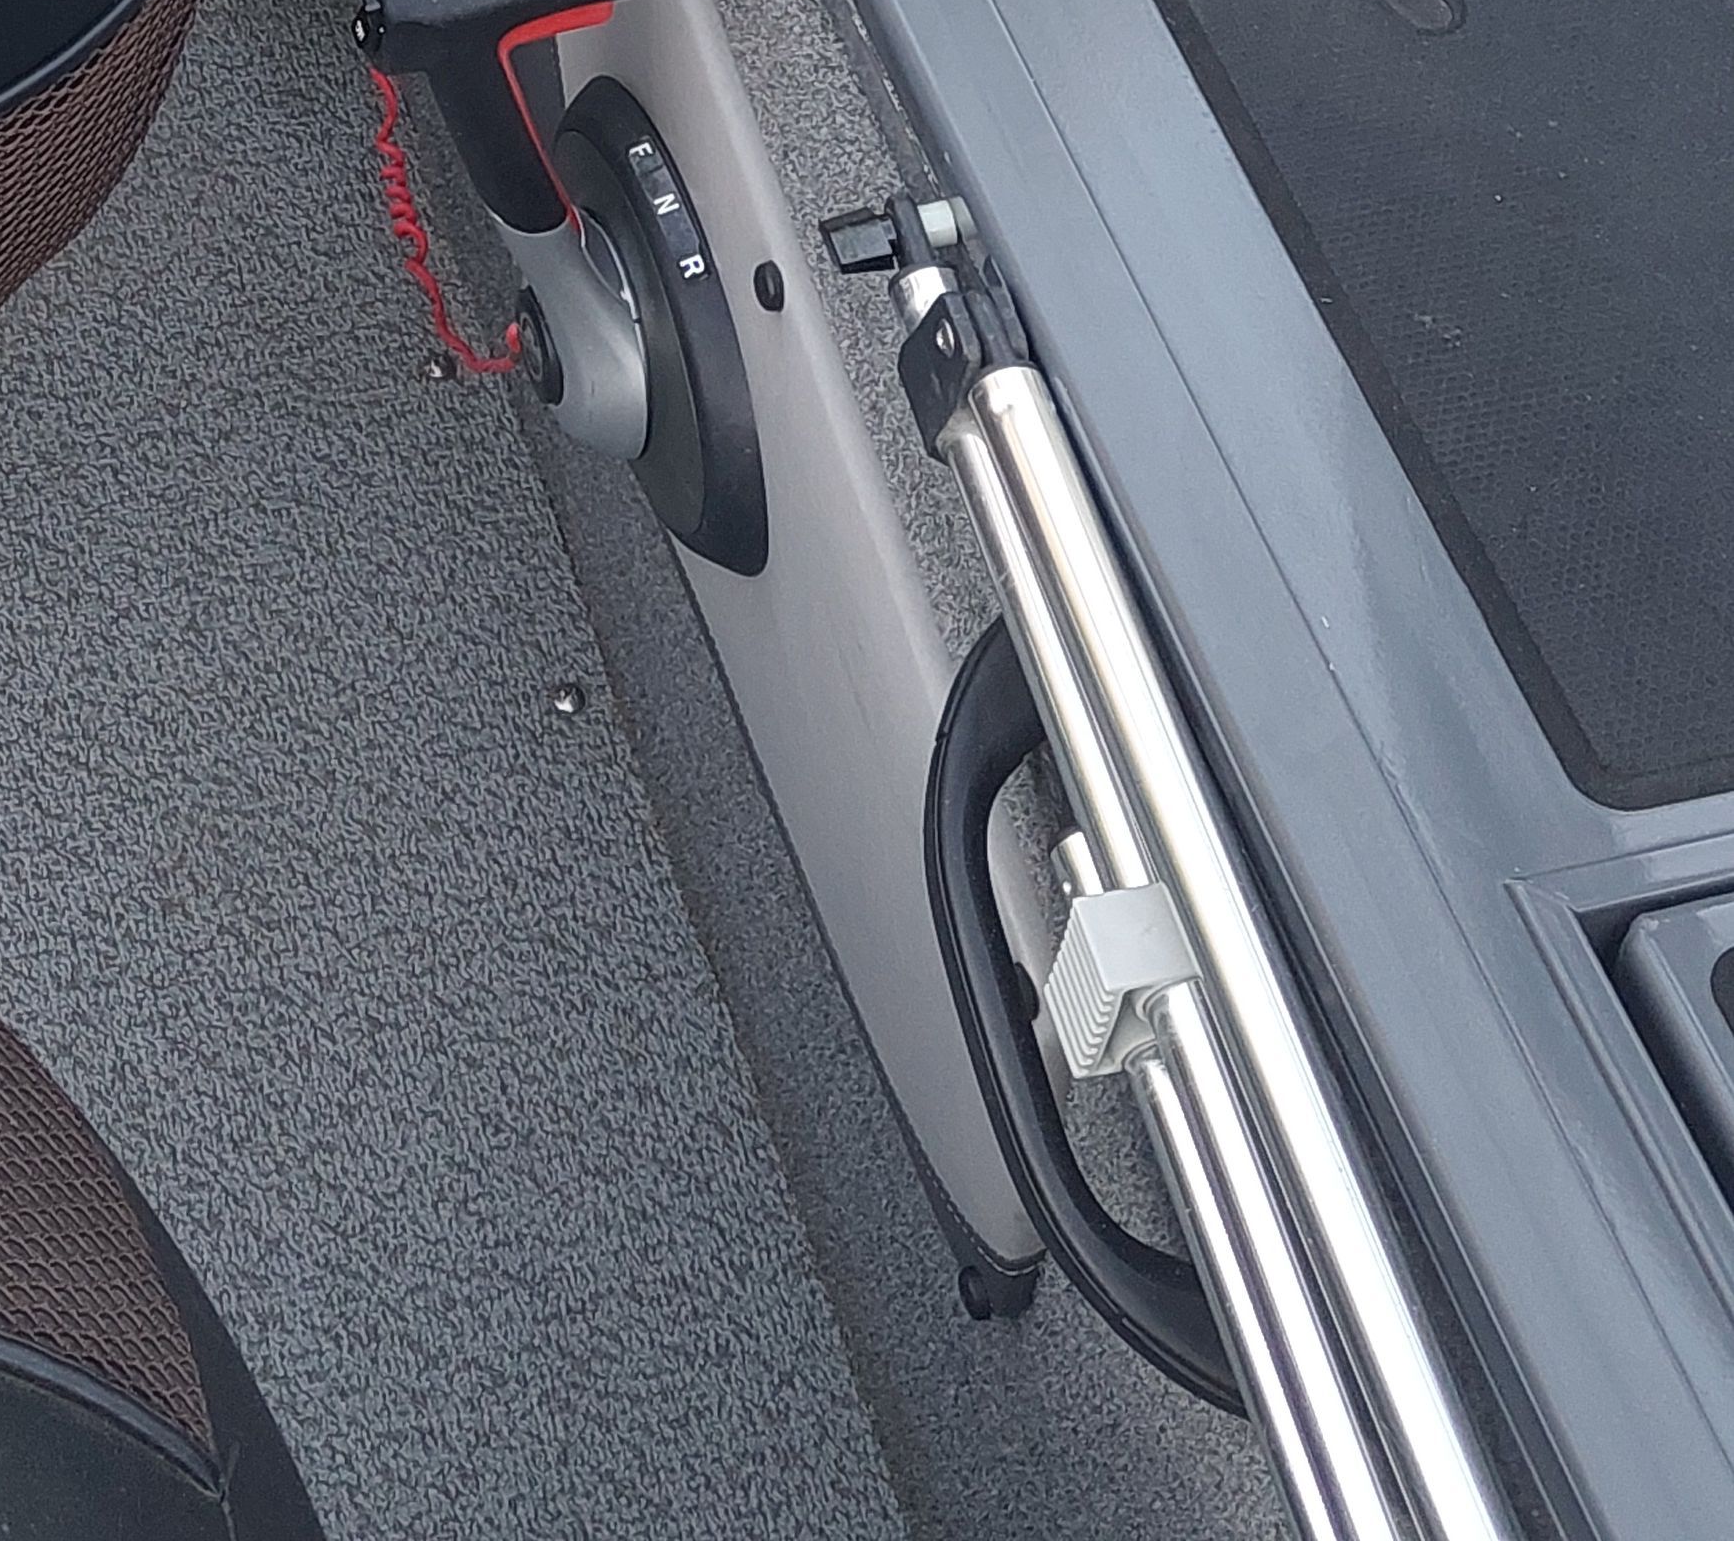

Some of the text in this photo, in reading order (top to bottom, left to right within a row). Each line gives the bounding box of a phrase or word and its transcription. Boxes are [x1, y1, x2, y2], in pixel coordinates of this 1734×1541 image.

[628, 142, 654, 157] F
[653, 193, 681, 215] N
[679, 254, 705, 279] R
